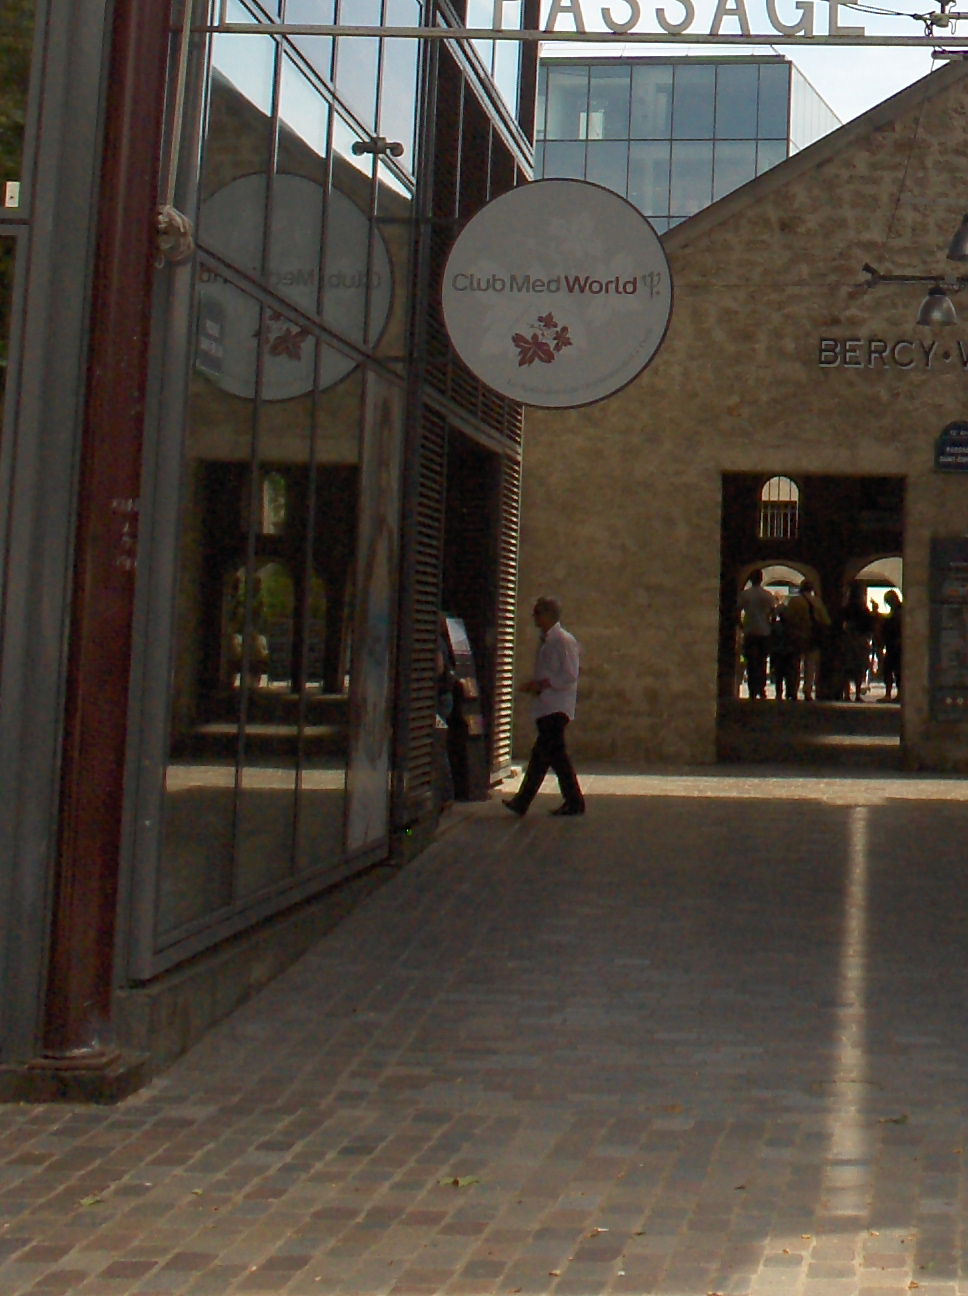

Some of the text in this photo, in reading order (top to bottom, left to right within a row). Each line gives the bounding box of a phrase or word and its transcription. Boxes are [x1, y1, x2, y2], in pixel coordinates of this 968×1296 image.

[450, 272, 638, 295] Club Med World
[818, 337, 938, 371] BERCY
